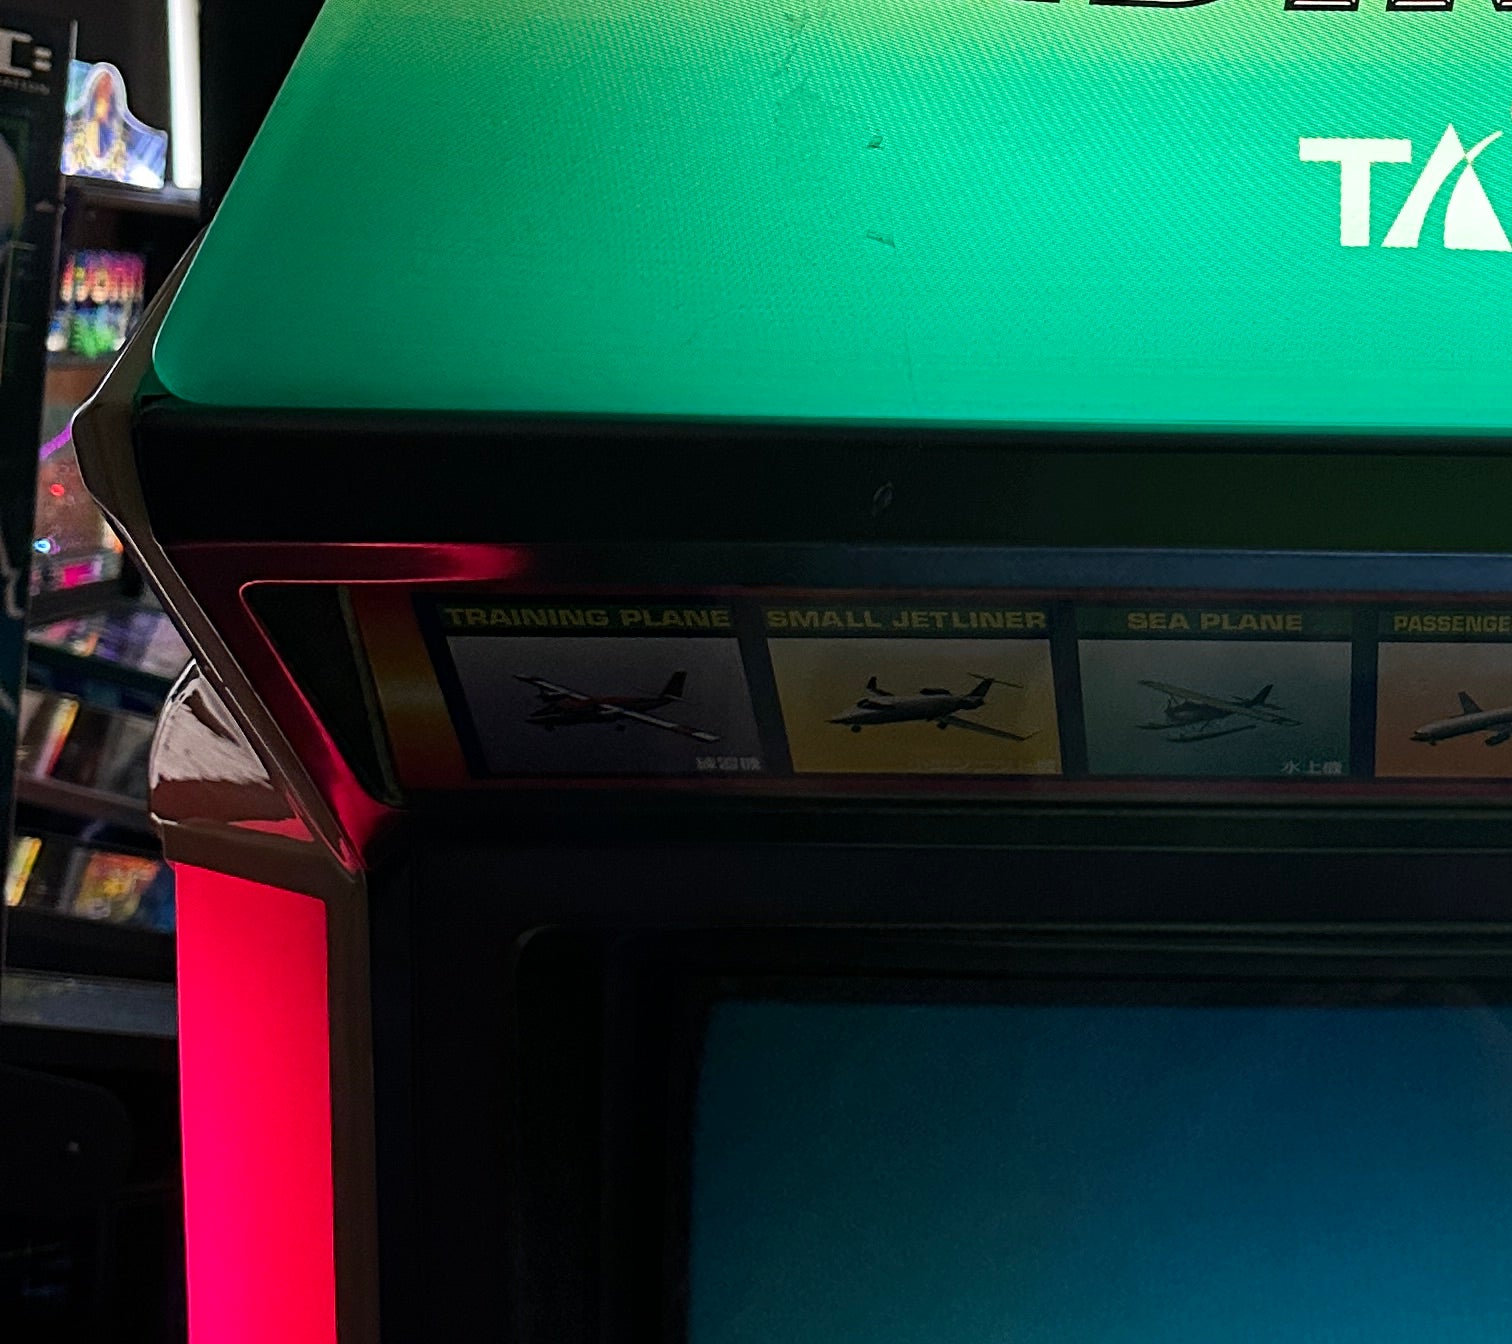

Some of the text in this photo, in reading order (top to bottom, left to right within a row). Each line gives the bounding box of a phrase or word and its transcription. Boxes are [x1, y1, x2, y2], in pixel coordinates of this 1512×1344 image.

[443, 607, 731, 628] TRAINING PLANE
[767, 610, 1047, 630] SMALL JETLINER
[1127, 612, 1304, 632] SEA PLANE
